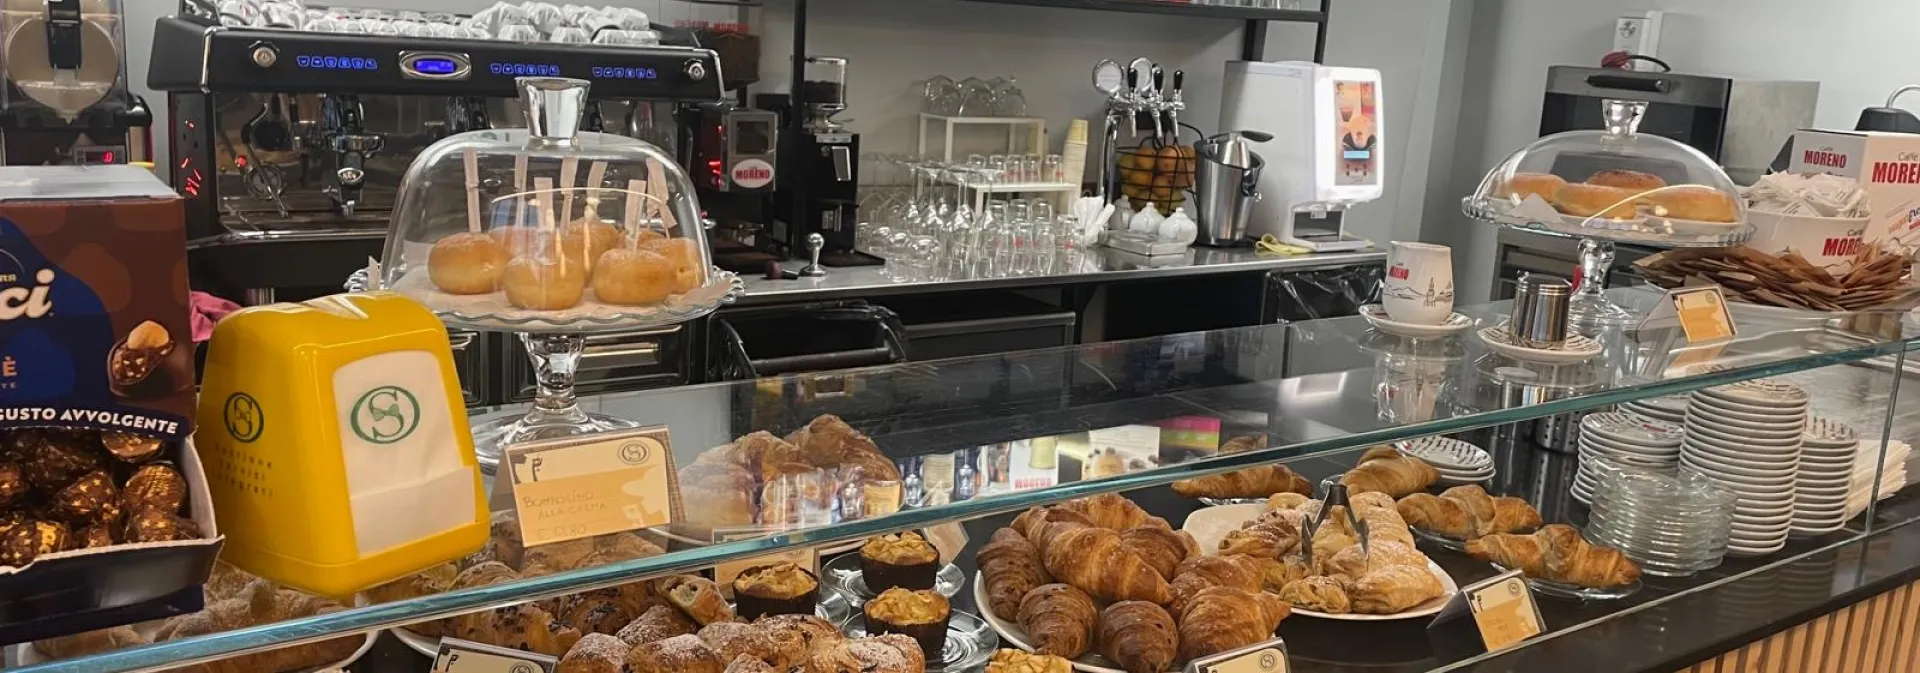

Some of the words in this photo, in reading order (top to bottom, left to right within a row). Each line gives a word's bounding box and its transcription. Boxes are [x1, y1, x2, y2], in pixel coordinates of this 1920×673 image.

[1804, 150, 1847, 168] MORENO
[735, 169, 770, 180] MORENO
[60, 408, 179, 434] AVVOLGENTE
